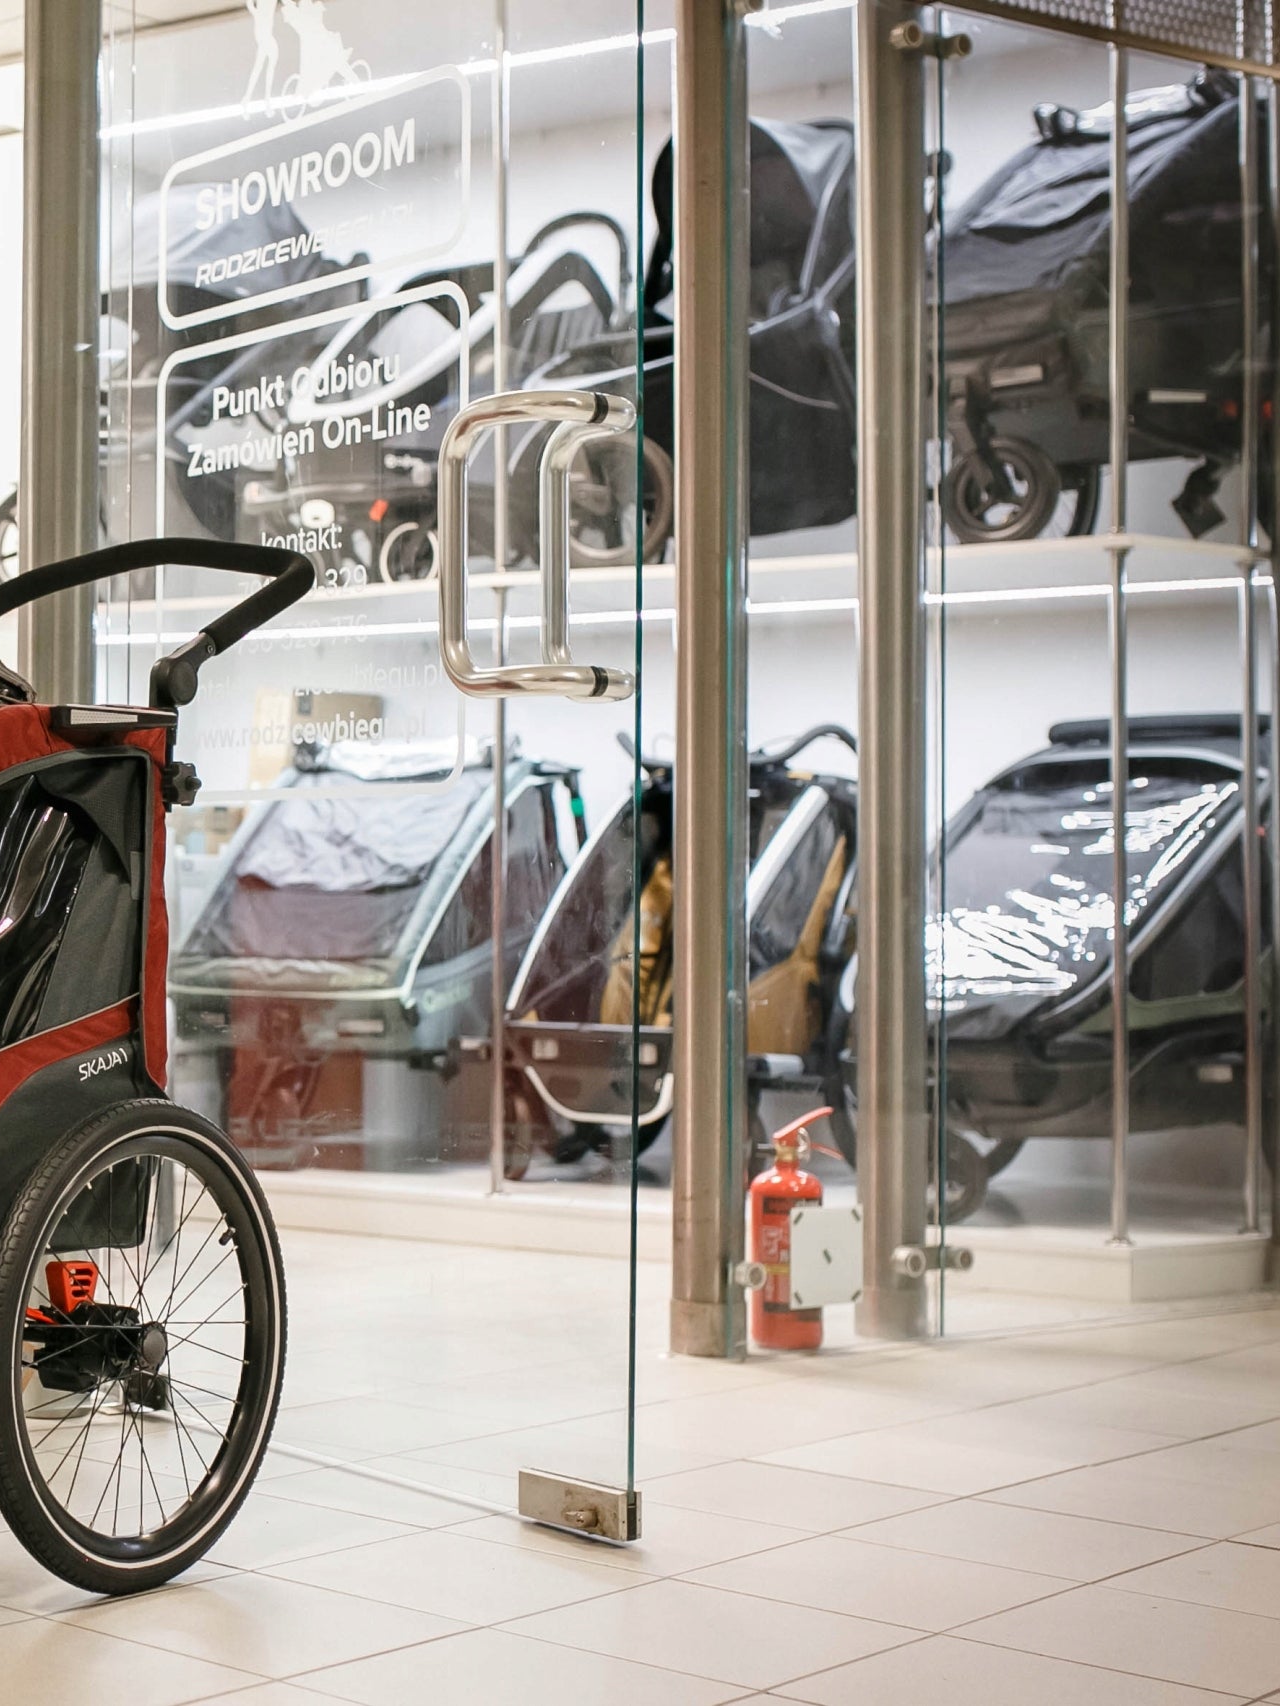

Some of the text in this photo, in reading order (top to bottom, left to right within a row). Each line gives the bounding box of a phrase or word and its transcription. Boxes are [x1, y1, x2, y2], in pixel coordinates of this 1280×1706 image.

[195, 118, 415, 231] SHOWROOM
[212, 375, 285, 421] Punkt
[187, 400, 432, 478] Zamówień On-Line
